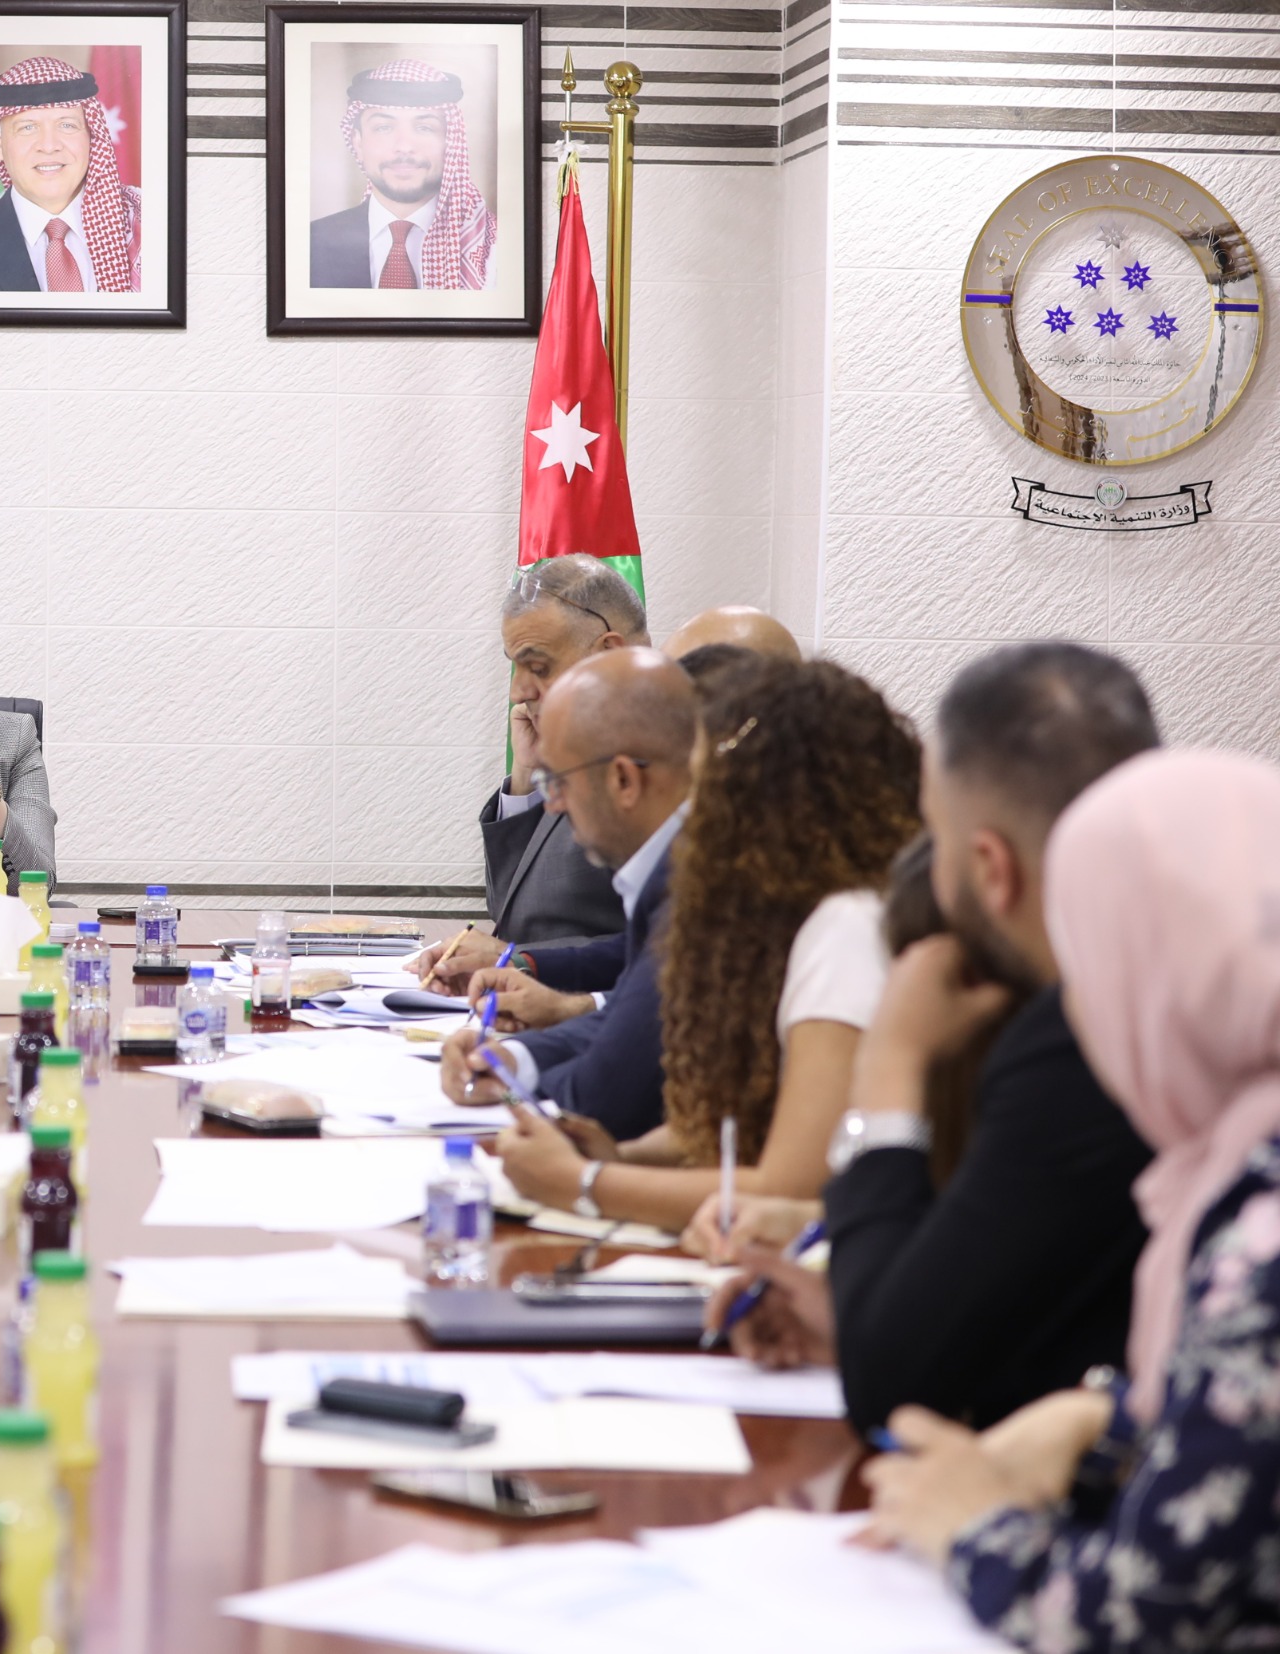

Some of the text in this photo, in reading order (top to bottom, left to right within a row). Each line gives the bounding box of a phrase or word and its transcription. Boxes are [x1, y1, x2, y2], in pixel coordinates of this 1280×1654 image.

[984, 174, 1239, 284] SEAL OF EXCELLENCE
[1110, 511, 1157, 525] التنمية
[1160, 503, 1190, 518] وزارة
